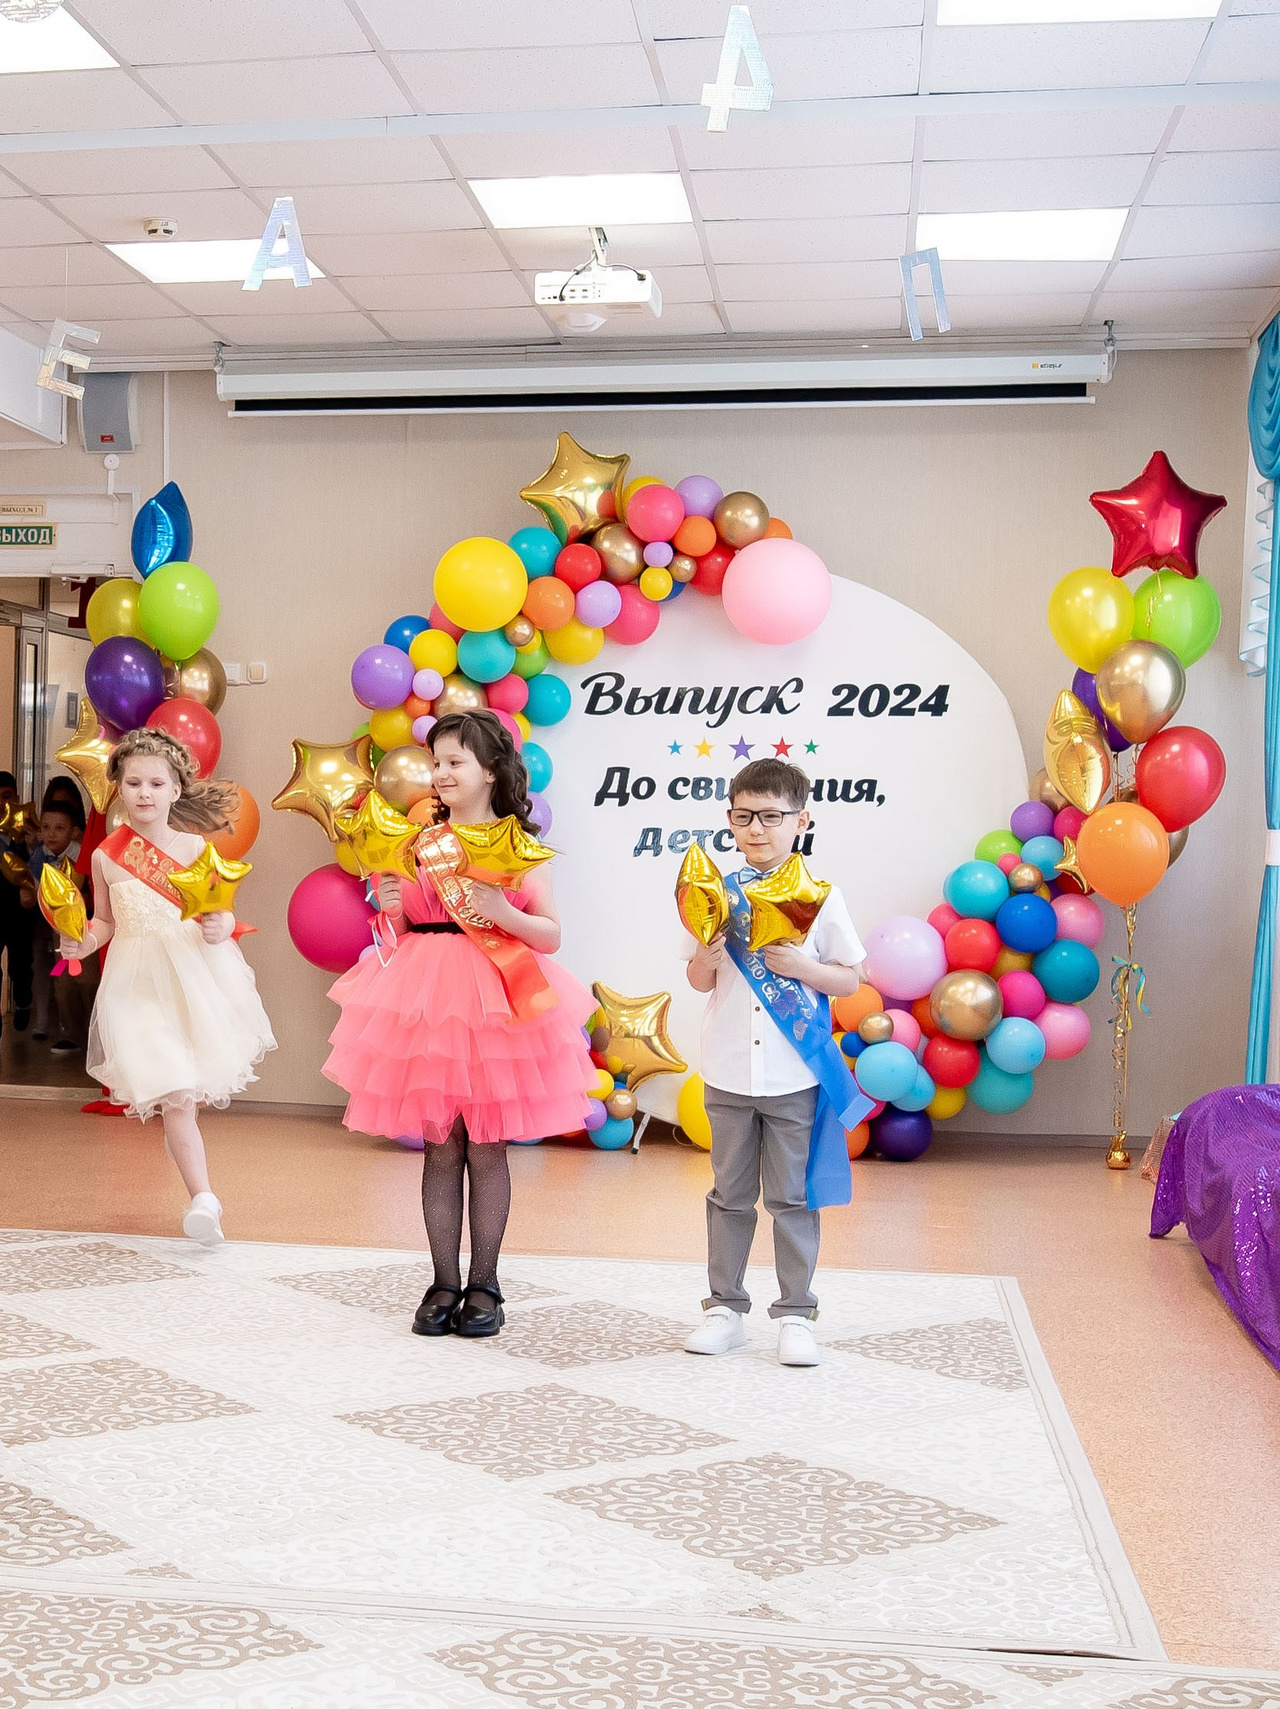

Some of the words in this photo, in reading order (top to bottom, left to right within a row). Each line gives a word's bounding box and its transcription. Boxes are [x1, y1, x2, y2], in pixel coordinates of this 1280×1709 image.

[580, 671, 803, 728] Выпуск
[826, 682, 951, 718] 2024
[593, 766, 656, 807] До
[667, 776, 886, 808] свиния,
[632, 819, 815, 858] детсй
